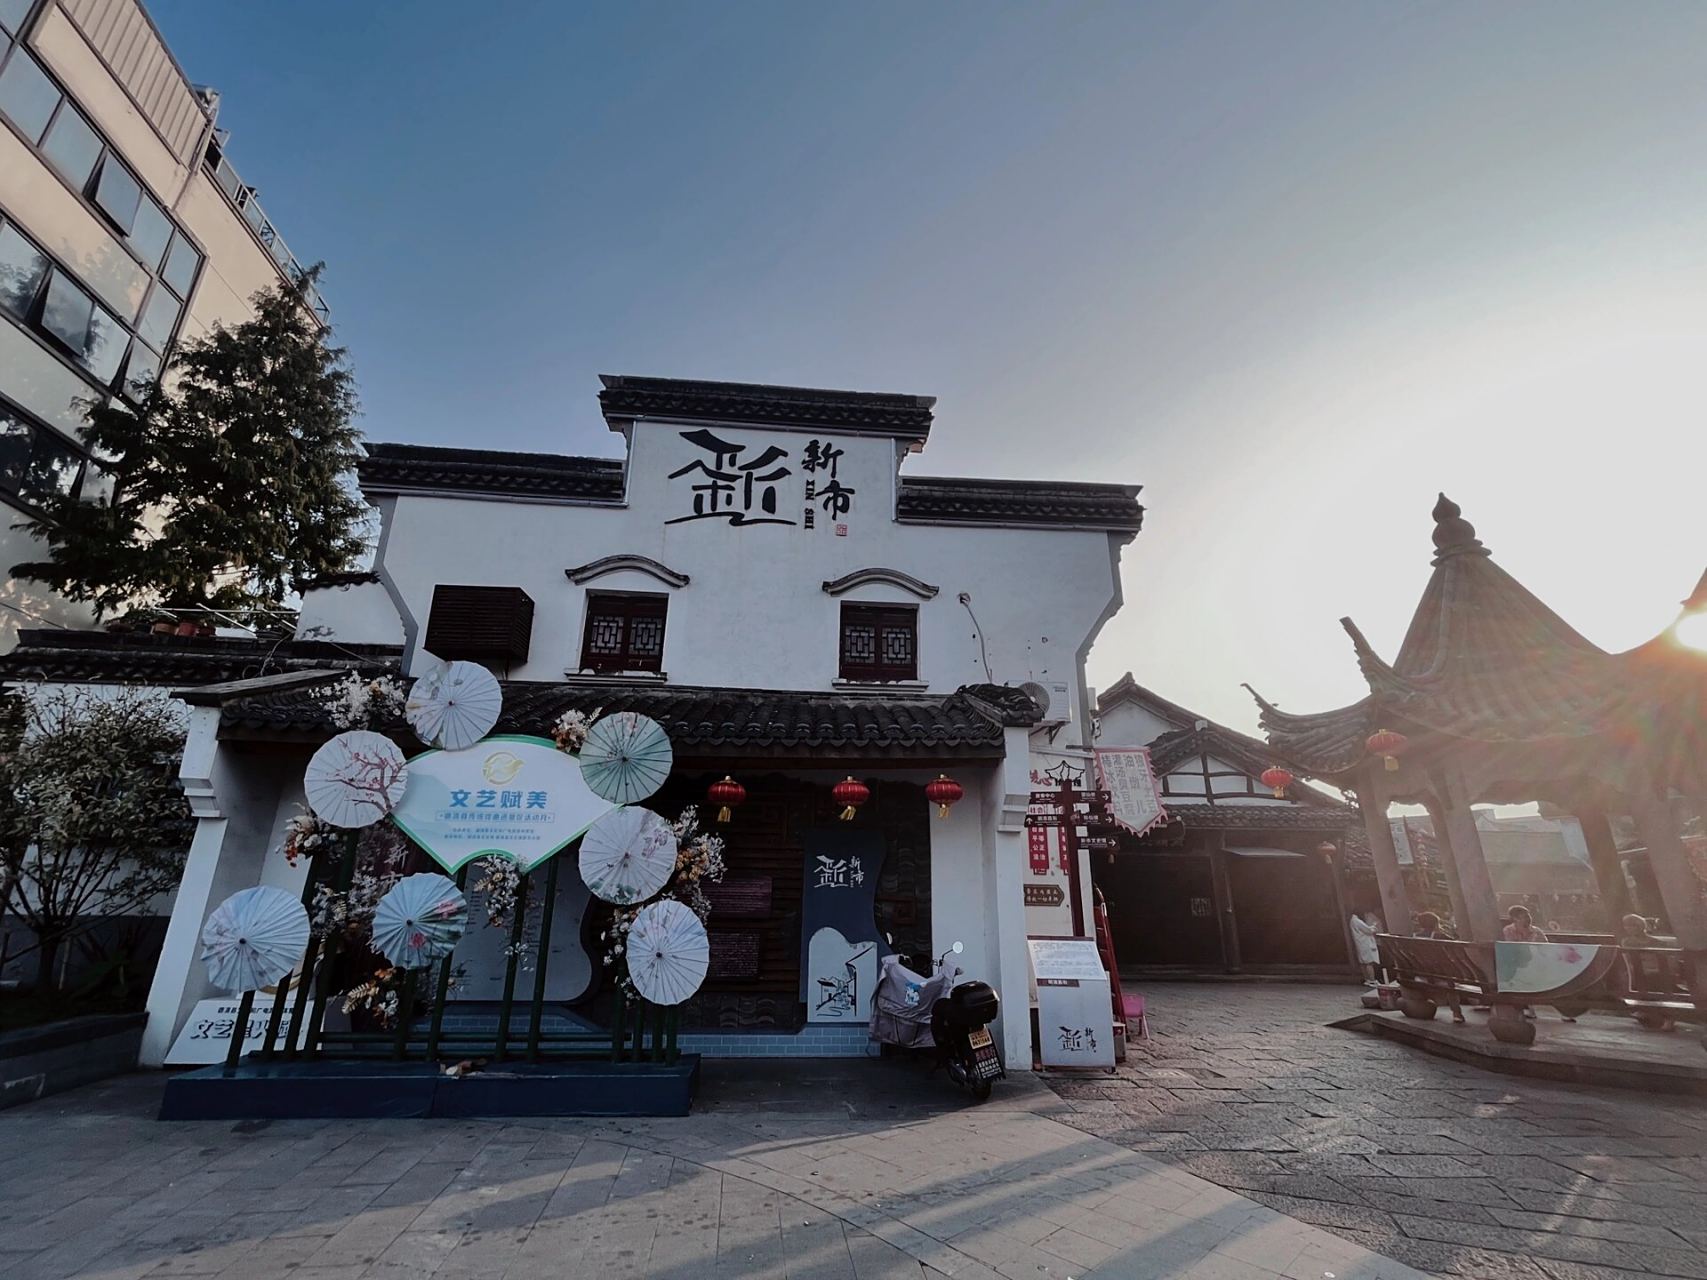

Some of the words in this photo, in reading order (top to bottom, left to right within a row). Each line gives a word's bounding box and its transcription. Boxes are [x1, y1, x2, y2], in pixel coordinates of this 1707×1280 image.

[802, 439, 855, 521] 新市
[805, 480, 815, 501] XIN
[804, 508, 815, 529] SHI
[449, 789, 548, 809] 文艺赋美
